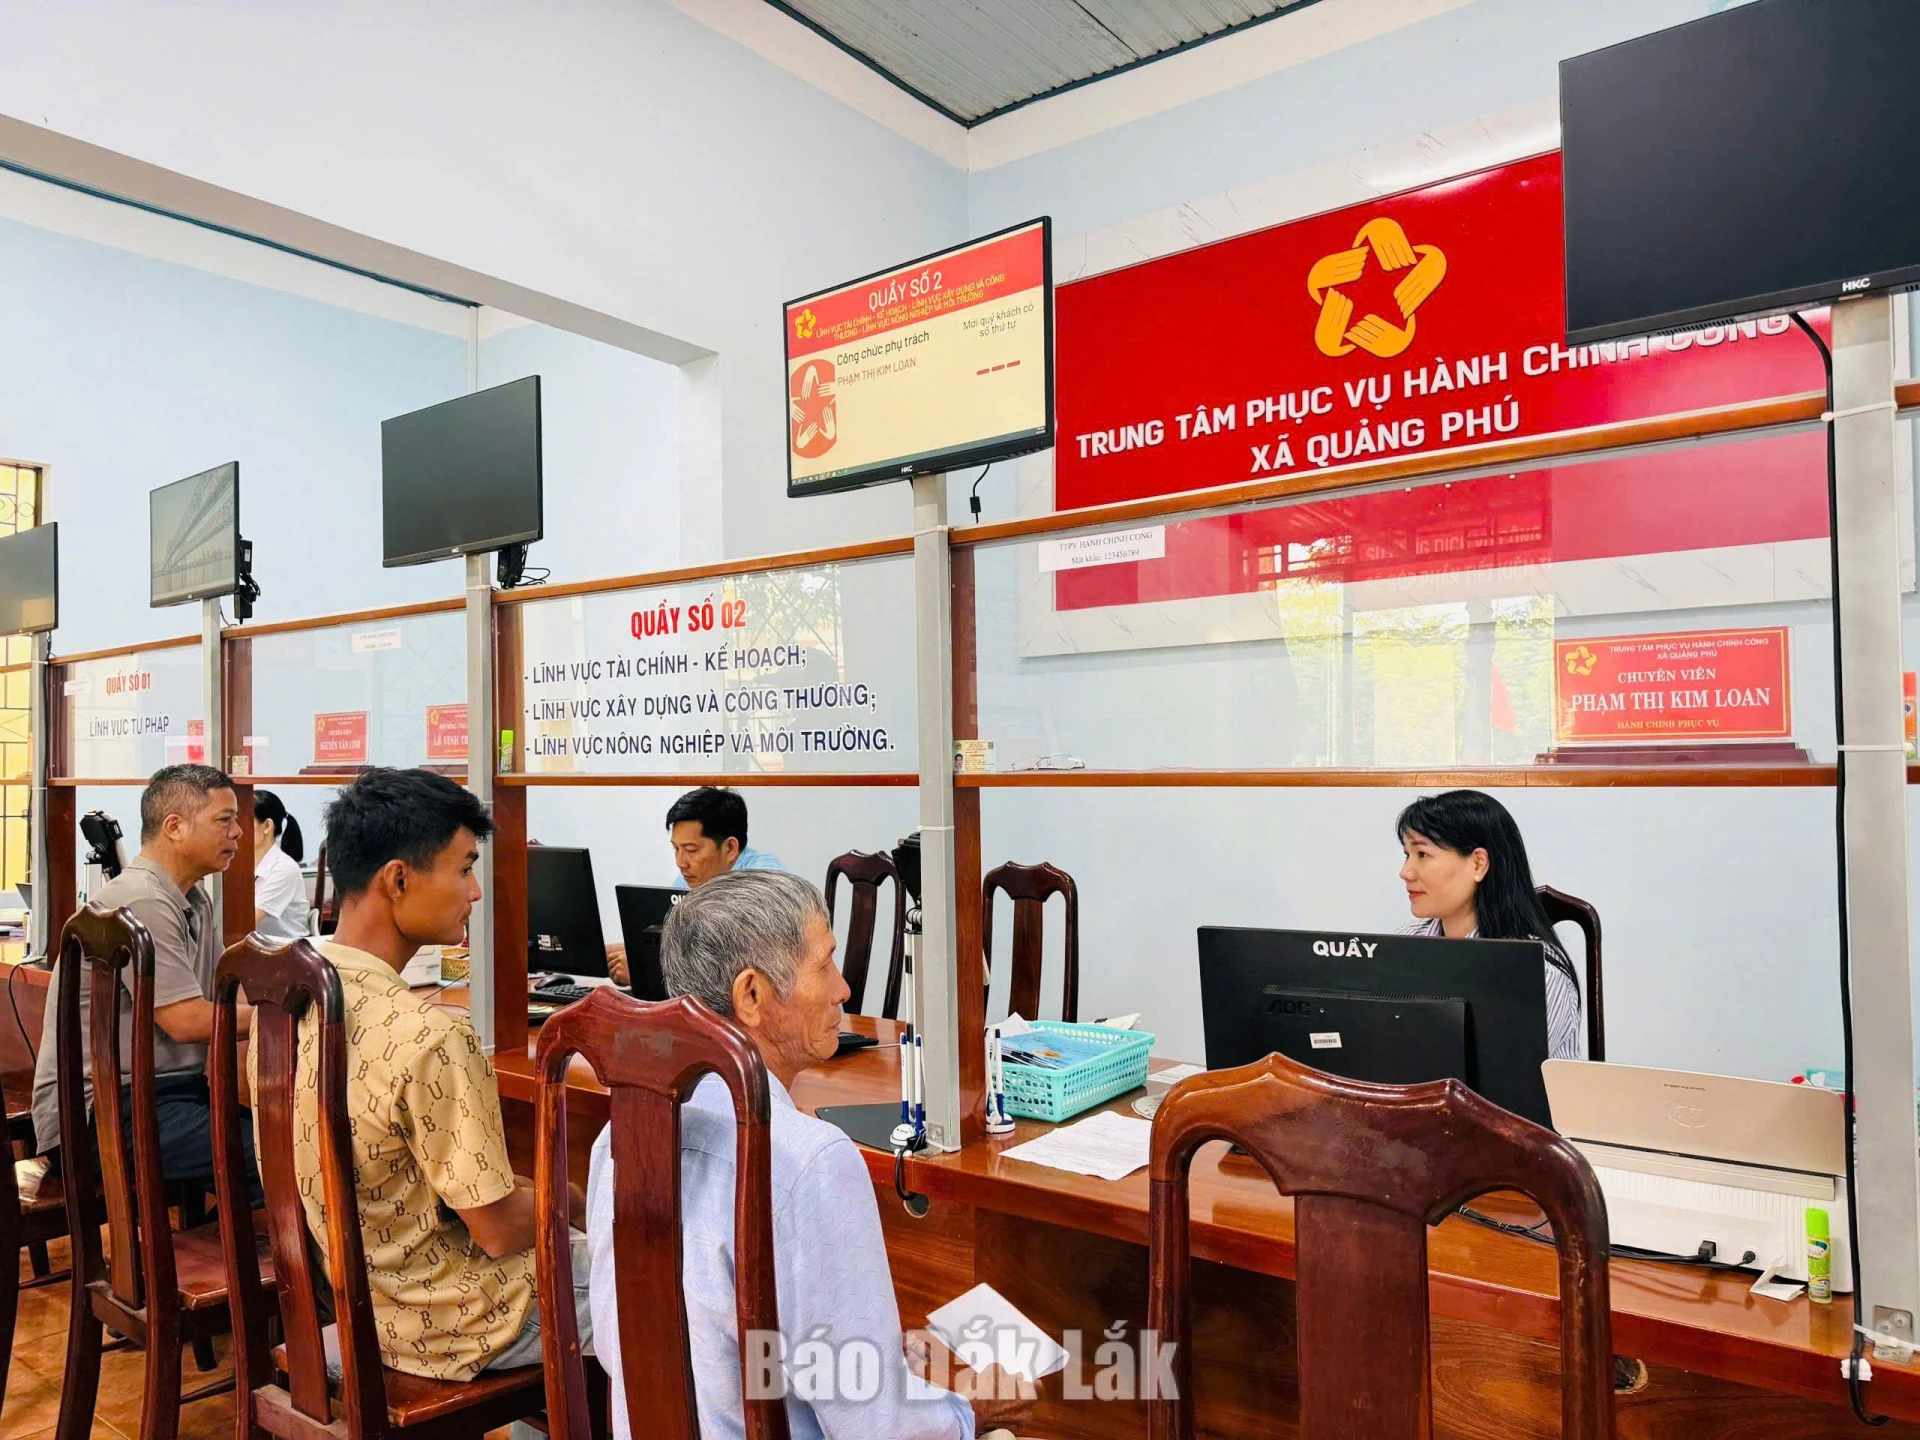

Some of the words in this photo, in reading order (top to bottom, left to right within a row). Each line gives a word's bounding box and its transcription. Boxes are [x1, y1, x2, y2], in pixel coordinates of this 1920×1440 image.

[868, 279, 906, 311] QUẦY
[910, 269, 930, 298] SỐ
[933, 271, 943, 290] 2
[1842, 278, 1871, 291] HKC
[963, 318, 978, 331] Mời
[980, 312, 994, 327] quý
[996, 305, 1021, 321] khách
[1023, 301, 1034, 313] có
[991, 321, 1006, 334] thứ
[837, 352, 859, 366] Công
[861, 344, 883, 360] chức
[885, 339, 902, 355] phụ
[904, 330, 929, 348] trách
[837, 371, 860, 387] PHẠM
[861, 367, 875, 381] THỊ
[876, 363, 891, 377] KIM
[893, 356, 917, 373] LOAN
[1076, 419, 1165, 459] TRUNG
[1175, 404, 1236, 440] TÂM
[1246, 386, 1333, 427] PHỤC
[1343, 373, 1392, 412] VỤ
[1403, 351, 1508, 398] HÀNH
[1250, 433, 1296, 473] XÃ
[1307, 418, 1425, 467] QUẢNG
[1441, 394, 1519, 442] PHÚ
[1104, 549, 1140, 561] 123456789
[631, 598, 681, 641] QUẦY
[687, 592, 715, 633] SỐ
[721, 600, 747, 629] 02
[1637, 643, 1654, 652] TÂM
[1656, 642, 1677, 652] PHỤC
[1679, 641, 1691, 650] VỤ
[1692, 639, 1715, 649] HÀNH
[1717, 638, 1743, 648] CHÍNH
[1744, 636, 1769, 646] CÔNG
[1657, 651, 1668, 660] XÃ
[1670, 650, 1698, 660] QUẢNG
[1700, 648, 1718, 658] PHÚ
[533, 662, 566, 684] LĨNH
[571, 660, 601, 684] VỰC
[606, 655, 631, 678] TÀI
[636, 651, 688, 676] CHÍNH
[705, 642, 728, 671] KẾ
[734, 644, 807, 672] HOẠCH;
[1617, 667, 1676, 684] CHUYÊN
[1680, 665, 1717, 681] VIÊN
[129, 666, 140, 692] SỐ
[141, 672, 151, 690] 01
[533, 698, 565, 721] LĨNH
[570, 697, 601, 722] VỰC
[606, 694, 637, 718] XÂY
[644, 694, 692, 720] DỰNG
[696, 688, 720, 714] VÀ
[725, 686, 778, 713] CÔNG
[783, 683, 876, 713] THƯƠNG;
[1571, 692, 1626, 716] PHẠM
[1630, 691, 1665, 714] THỊ
[1670, 689, 1709, 709] KIM
[1715, 687, 1771, 708] LOAN
[90, 717, 109, 737] LĨNH
[111, 717, 129, 739] VỰC
[131, 715, 144, 735] TƯ
[145, 711, 170, 734] PHÁP
[1617, 719, 1644, 729] HÀNH
[1646, 718, 1675, 729] CHÍNH
[1678, 718, 1704, 730] PHỤC
[1707, 718, 1721, 729] VỤ
[534, 734, 567, 756] LĨNH
[572, 734, 603, 759] VỰC
[606, 732, 652, 755] NÔNG
[660, 729, 725, 758] NGHIỆP
[731, 729, 754, 753] VÀ
[760, 726, 794, 753] MÔI
[800, 723, 894, 752] TRƯỜNG.
[1312, 937, 1378, 958] QUẦY
